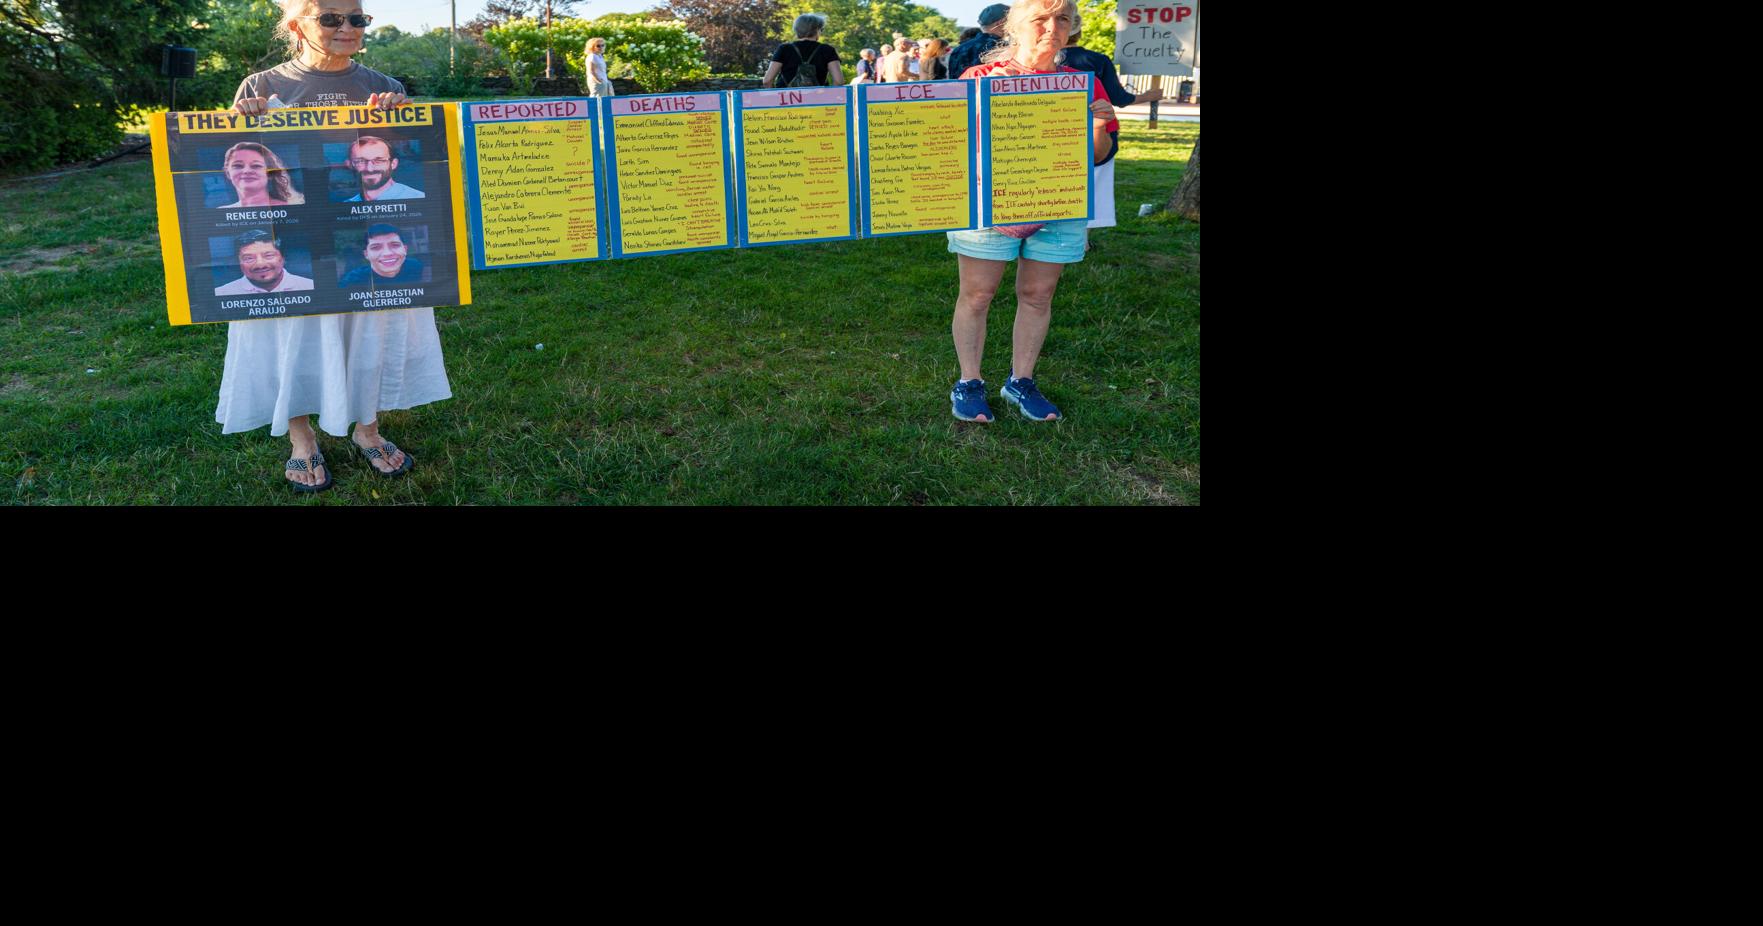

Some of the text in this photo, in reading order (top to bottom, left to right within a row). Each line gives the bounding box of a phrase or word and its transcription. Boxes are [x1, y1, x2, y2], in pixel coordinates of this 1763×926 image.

[1128, 7, 1191, 23] STOP
[1139, 26, 1172, 39] The
[1122, 42, 1185, 62] Cruelty
[479, 75, 1085, 118] REPORTED DEATHS IN ICE DETENTION
[184, 106, 427, 129] THEY DESERVE JUSTICE
[993, 189, 1006, 197] ICE
[226, 210, 287, 220] RENEE GOOD
[351, 204, 406, 214] ALEX PRETTI
[348, 288, 424, 300] JOAN SEBASTIAN
[221, 296, 311, 309] LORENZO SALGADO
[363, 297, 411, 307] GUERRERO
[248, 306, 286, 316] ARAUJO
